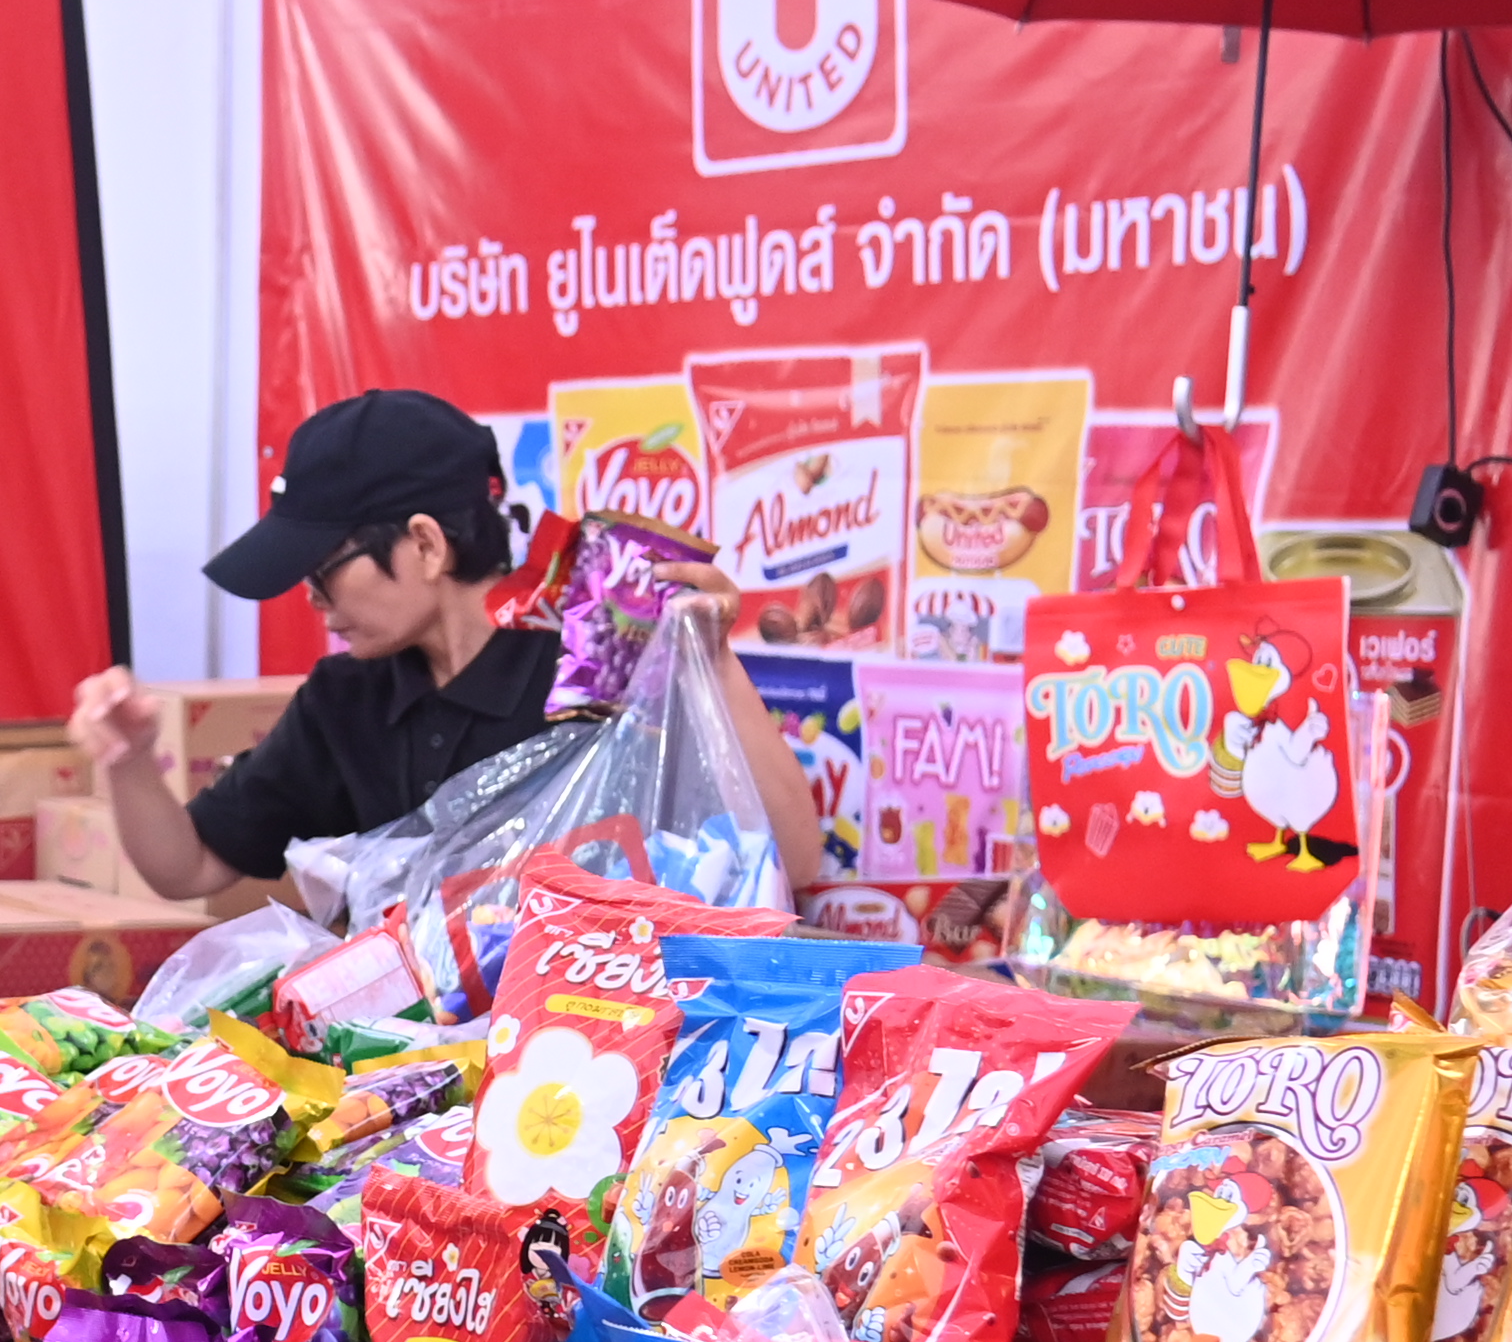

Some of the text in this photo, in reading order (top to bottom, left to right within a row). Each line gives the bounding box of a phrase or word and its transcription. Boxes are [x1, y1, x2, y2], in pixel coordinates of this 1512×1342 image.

[734, 21, 862, 114] UNITED
[409, 164, 1307, 336] บริษัท ยูไนเต็ดฟูดส์ จำกัด (มหาชน)
[734, 467, 881, 573] Almond
[1157, 634, 1208, 659] CUTE
[1359, 629, 1438, 662] เวเฟอร์
[891, 714, 1004, 791] FAM!
[1027, 664, 1214, 778] TORO
[162, 1044, 262, 1117] Yoyo
[1167, 1045, 1383, 1161] TORO
[260, 1259, 312, 1279] JELLY
